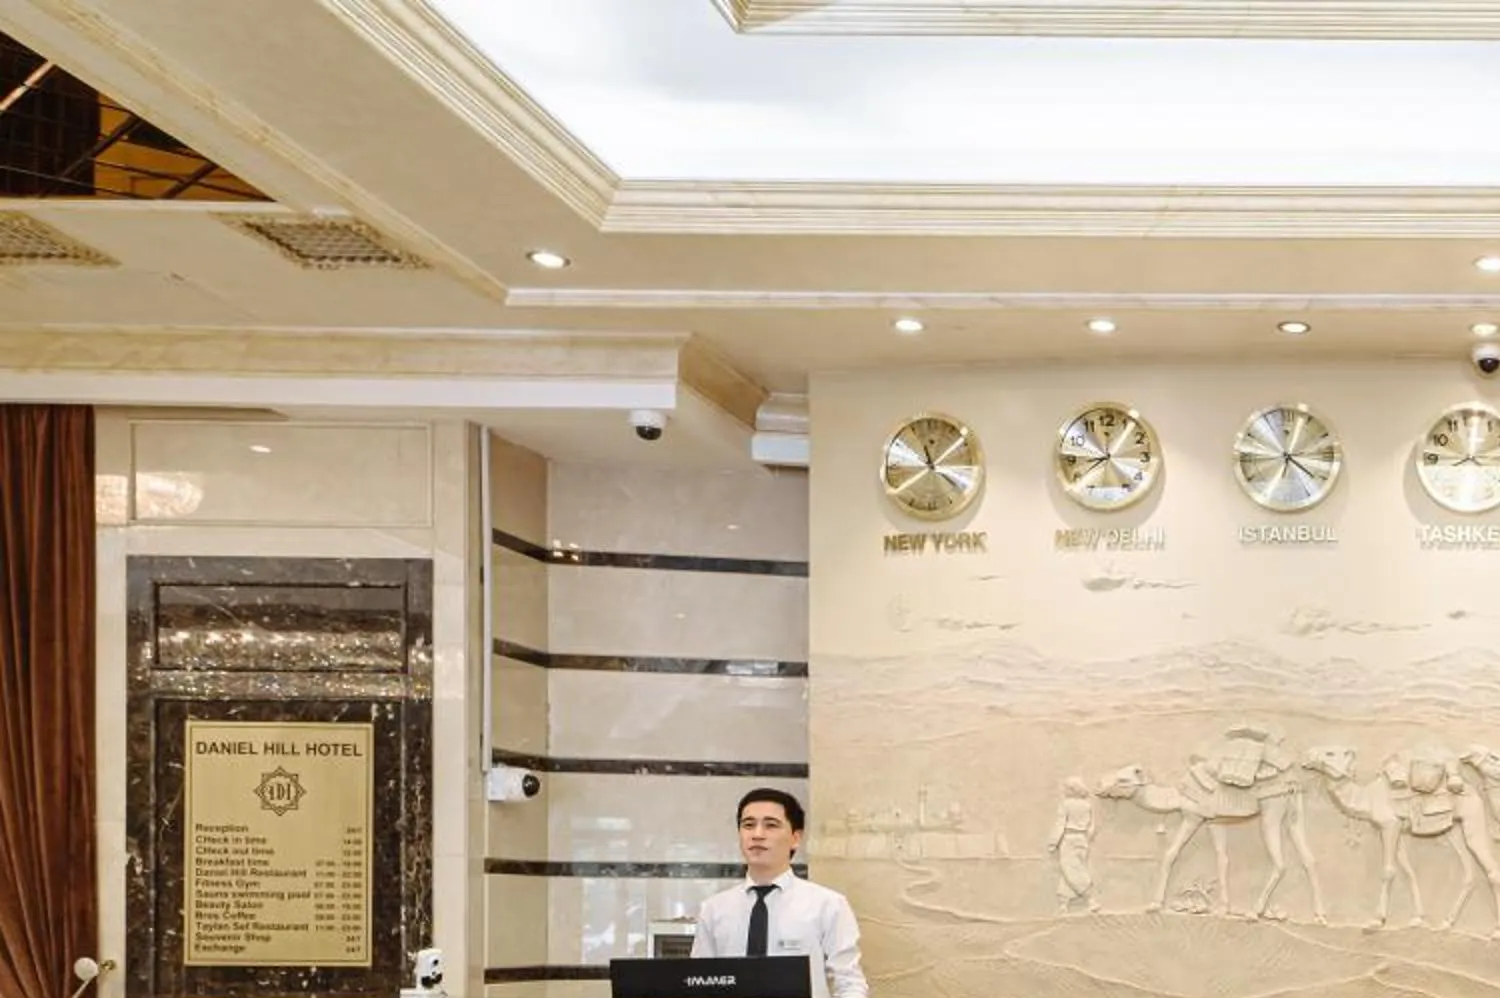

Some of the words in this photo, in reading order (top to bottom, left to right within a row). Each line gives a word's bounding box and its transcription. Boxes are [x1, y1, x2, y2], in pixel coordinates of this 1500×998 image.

[1083, 418, 1095, 432] 11
[1099, 414, 1115, 427] 12
[1447, 419, 1458, 432] 11
[1071, 435, 1086, 446] 10
[1135, 431, 1145, 445] 2
[1432, 434, 1449, 447] 10
[1140, 452, 1151, 463] 3
[1427, 453, 1439, 464] 9
[1055, 528, 1101, 547] NEW
[1106, 527, 1165, 547] DELHI
[1239, 526, 1339, 543] ISTANBUL
[884, 534, 928, 552] NEW
[932, 532, 987, 552] YORK
[196, 741, 258, 755] DANIEL
[264, 742, 300, 756] HILL
[305, 743, 363, 757] HOTEL
[195, 823, 249, 833] Reception
[245, 836, 267, 844] time
[232, 847, 248, 855] out
[251, 847, 275, 855] time
[195, 857, 245, 866] Breakfast
[248, 858, 269, 866] time
[195, 867, 228, 876] Daniel
[250, 868, 307, 877] Restaurant
[195, 878, 233, 888] Fitness
[235, 879, 261, 889] Gym
[195, 889, 229, 898] Sauna
[232, 891, 285, 900] swimming
[195, 900, 230, 913] Beauty
[233, 900, 264, 908] Salon
[222, 911, 256, 920] Coffee
[252, 922, 309, 931] Restaurant
[195, 932, 241, 941] Souvenir
[243, 932, 272, 942] Shop
[194, 943, 246, 954] Exchange
